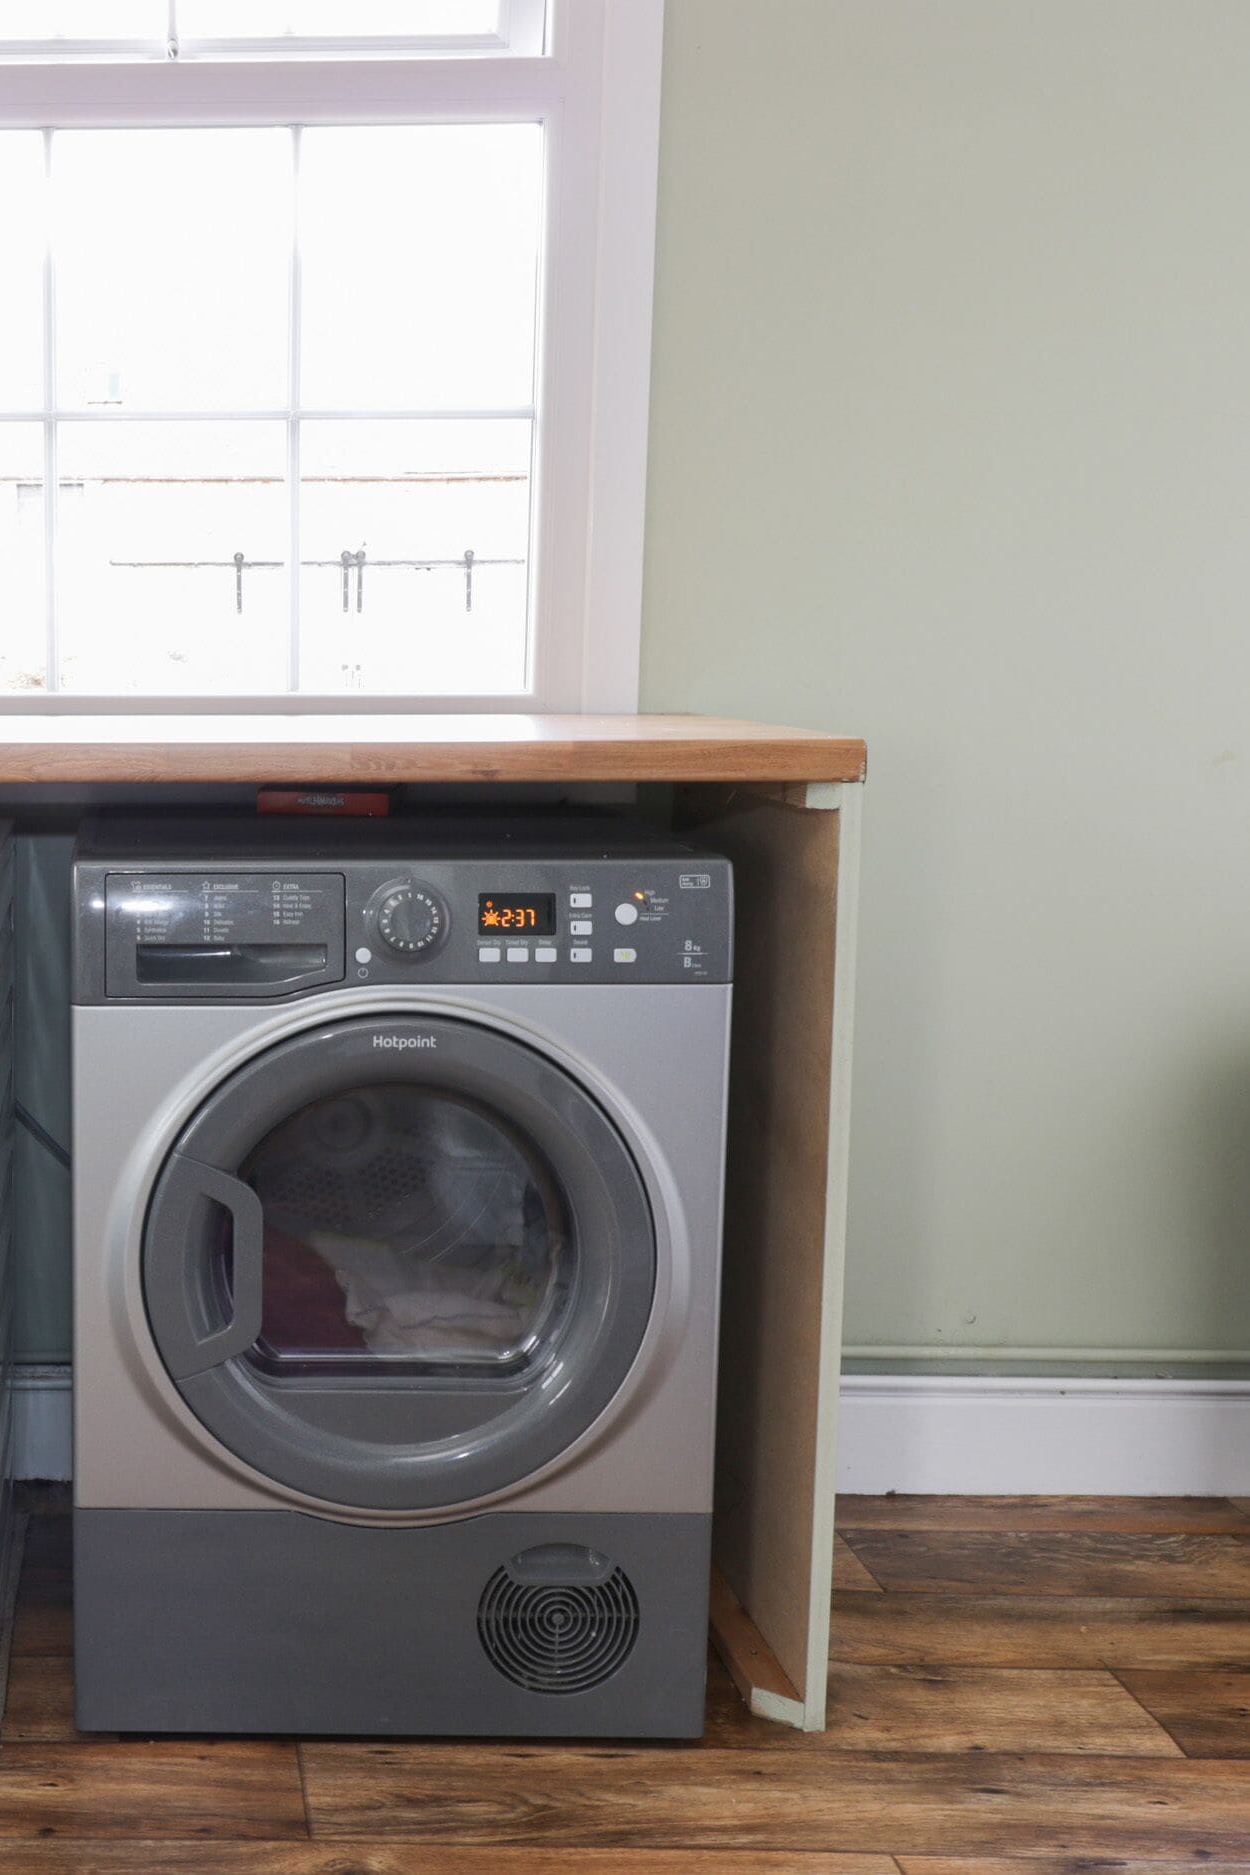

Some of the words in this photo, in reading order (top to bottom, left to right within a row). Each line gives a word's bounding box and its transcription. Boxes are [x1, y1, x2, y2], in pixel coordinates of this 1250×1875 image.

[501, 908, 536, 927] 2:37
[684, 939, 693, 952] 8
[683, 957, 692, 968] B
[372, 1035, 438, 1051] Hotpoint
